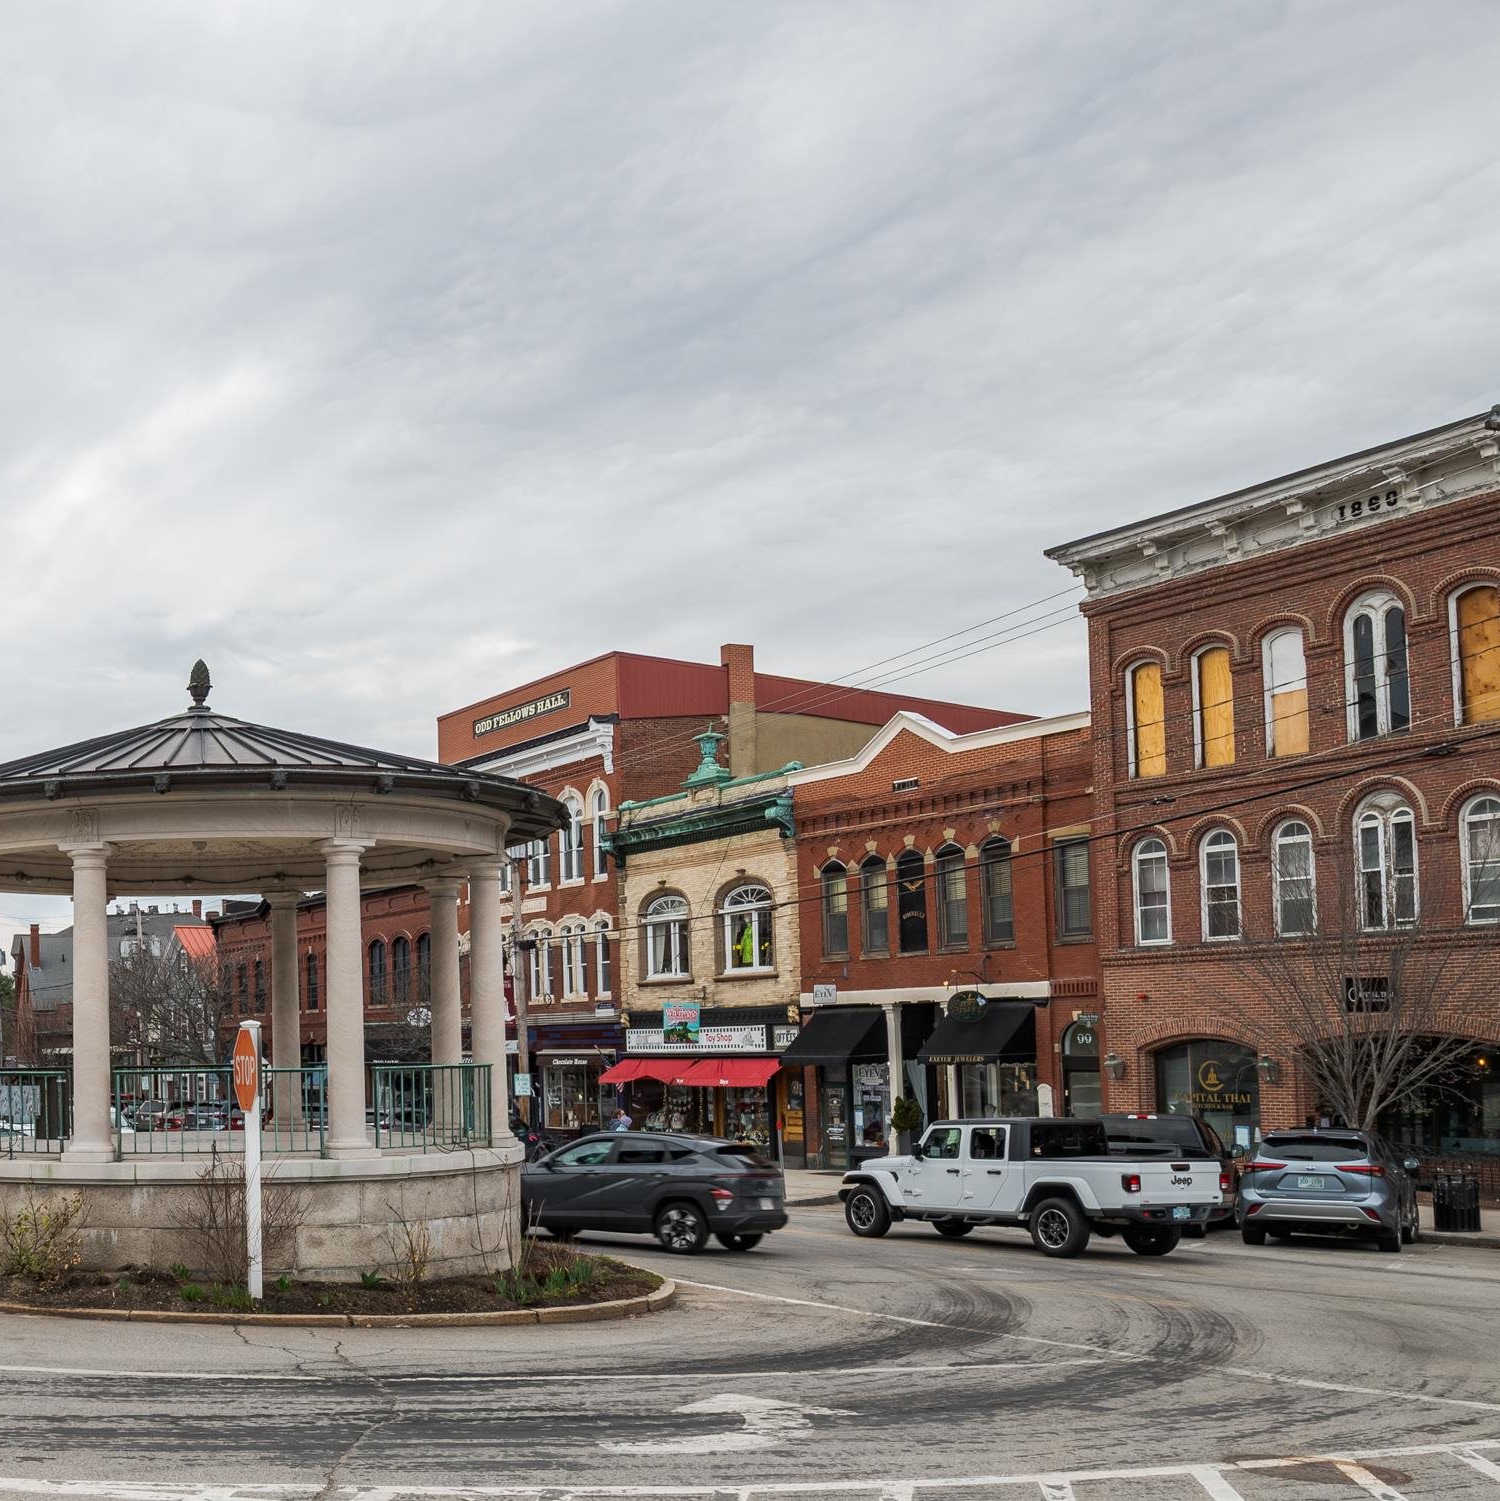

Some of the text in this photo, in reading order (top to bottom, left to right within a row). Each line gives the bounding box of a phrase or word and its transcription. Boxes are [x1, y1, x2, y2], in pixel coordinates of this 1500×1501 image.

[475, 719, 493, 734] ODD
[493, 704, 536, 729] FELLOWS
[705, 1033, 733, 1044] Toy Shop
[1077, 1033, 1092, 1044] 99
[953, 1055, 985, 1063] JEWELERS
[235, 1055, 255, 1086] STOP
[1222, 1091, 1252, 1103] THAI
[1170, 1175, 1192, 1186] Jeep
